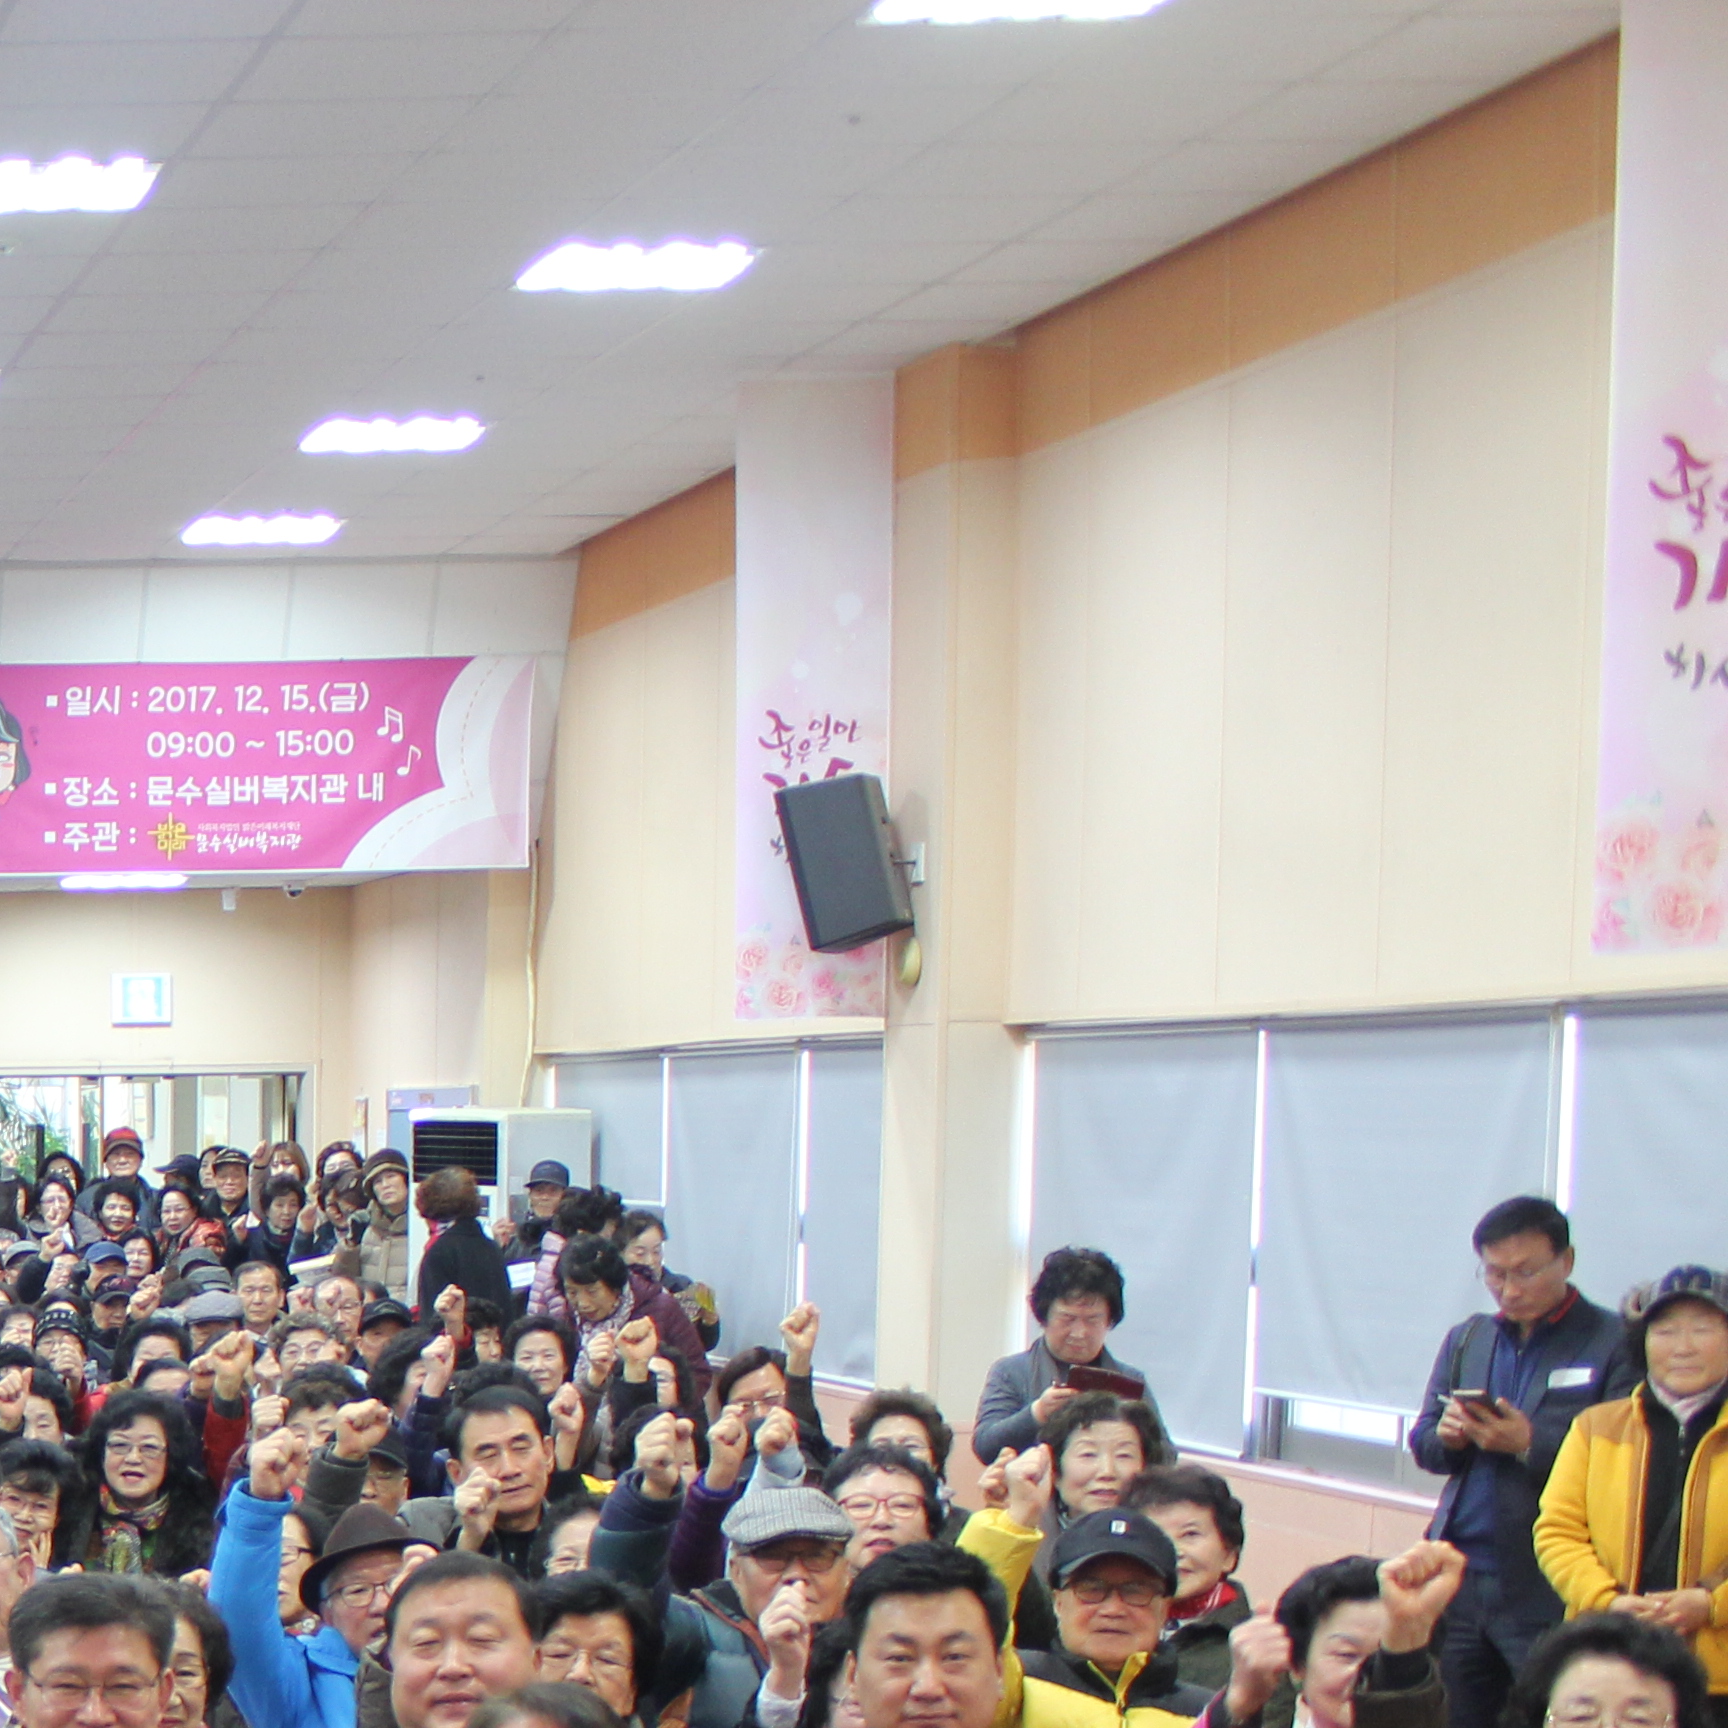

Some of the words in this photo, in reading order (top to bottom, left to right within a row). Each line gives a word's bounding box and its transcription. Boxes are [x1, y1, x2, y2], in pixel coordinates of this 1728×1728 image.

[65, 685, 122, 717] 일시
[147, 686, 225, 716] 2017.
[234, 685, 271, 715] 12.
[280, 681, 371, 714] 15.(금)
[146, 731, 237, 759] 09:00
[275, 728, 356, 758] 15:00
[62, 776, 121, 808] 장소
[146, 773, 351, 806] 문수실버복지관
[357, 772, 386, 804] 내
[62, 821, 121, 853] 주관
